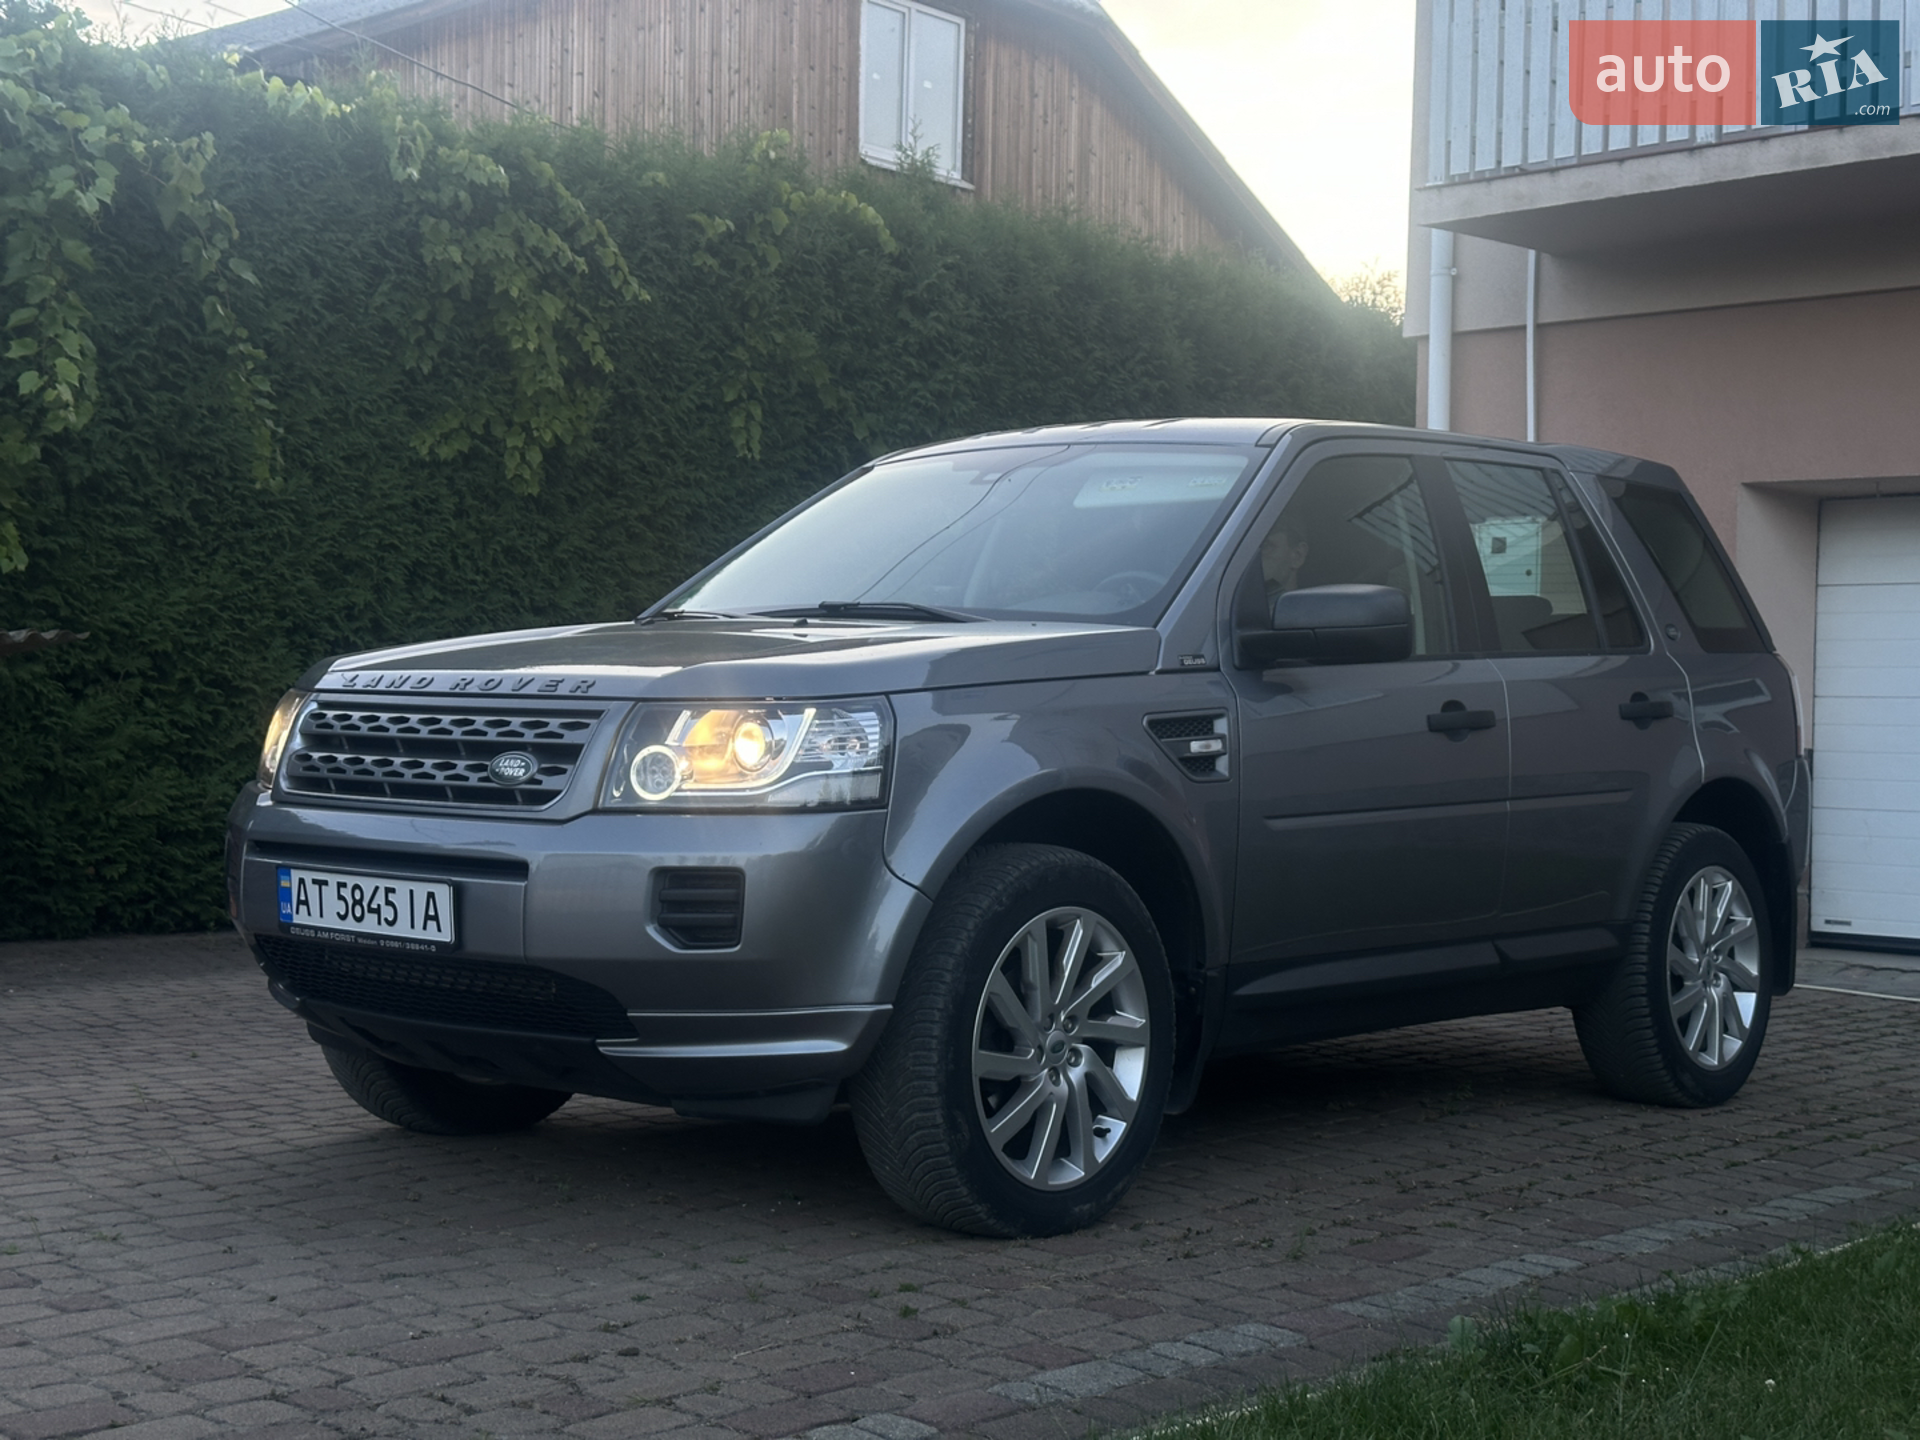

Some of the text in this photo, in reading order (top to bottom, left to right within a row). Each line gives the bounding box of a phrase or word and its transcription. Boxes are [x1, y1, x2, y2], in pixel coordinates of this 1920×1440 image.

[341, 673, 597, 694] LAND ROVER
[280, 901, 292, 914] UA
[295, 877, 442, 933] AT 5845 IA
[316, 930, 330, 939] AM
[330, 932, 356, 943] FORST
